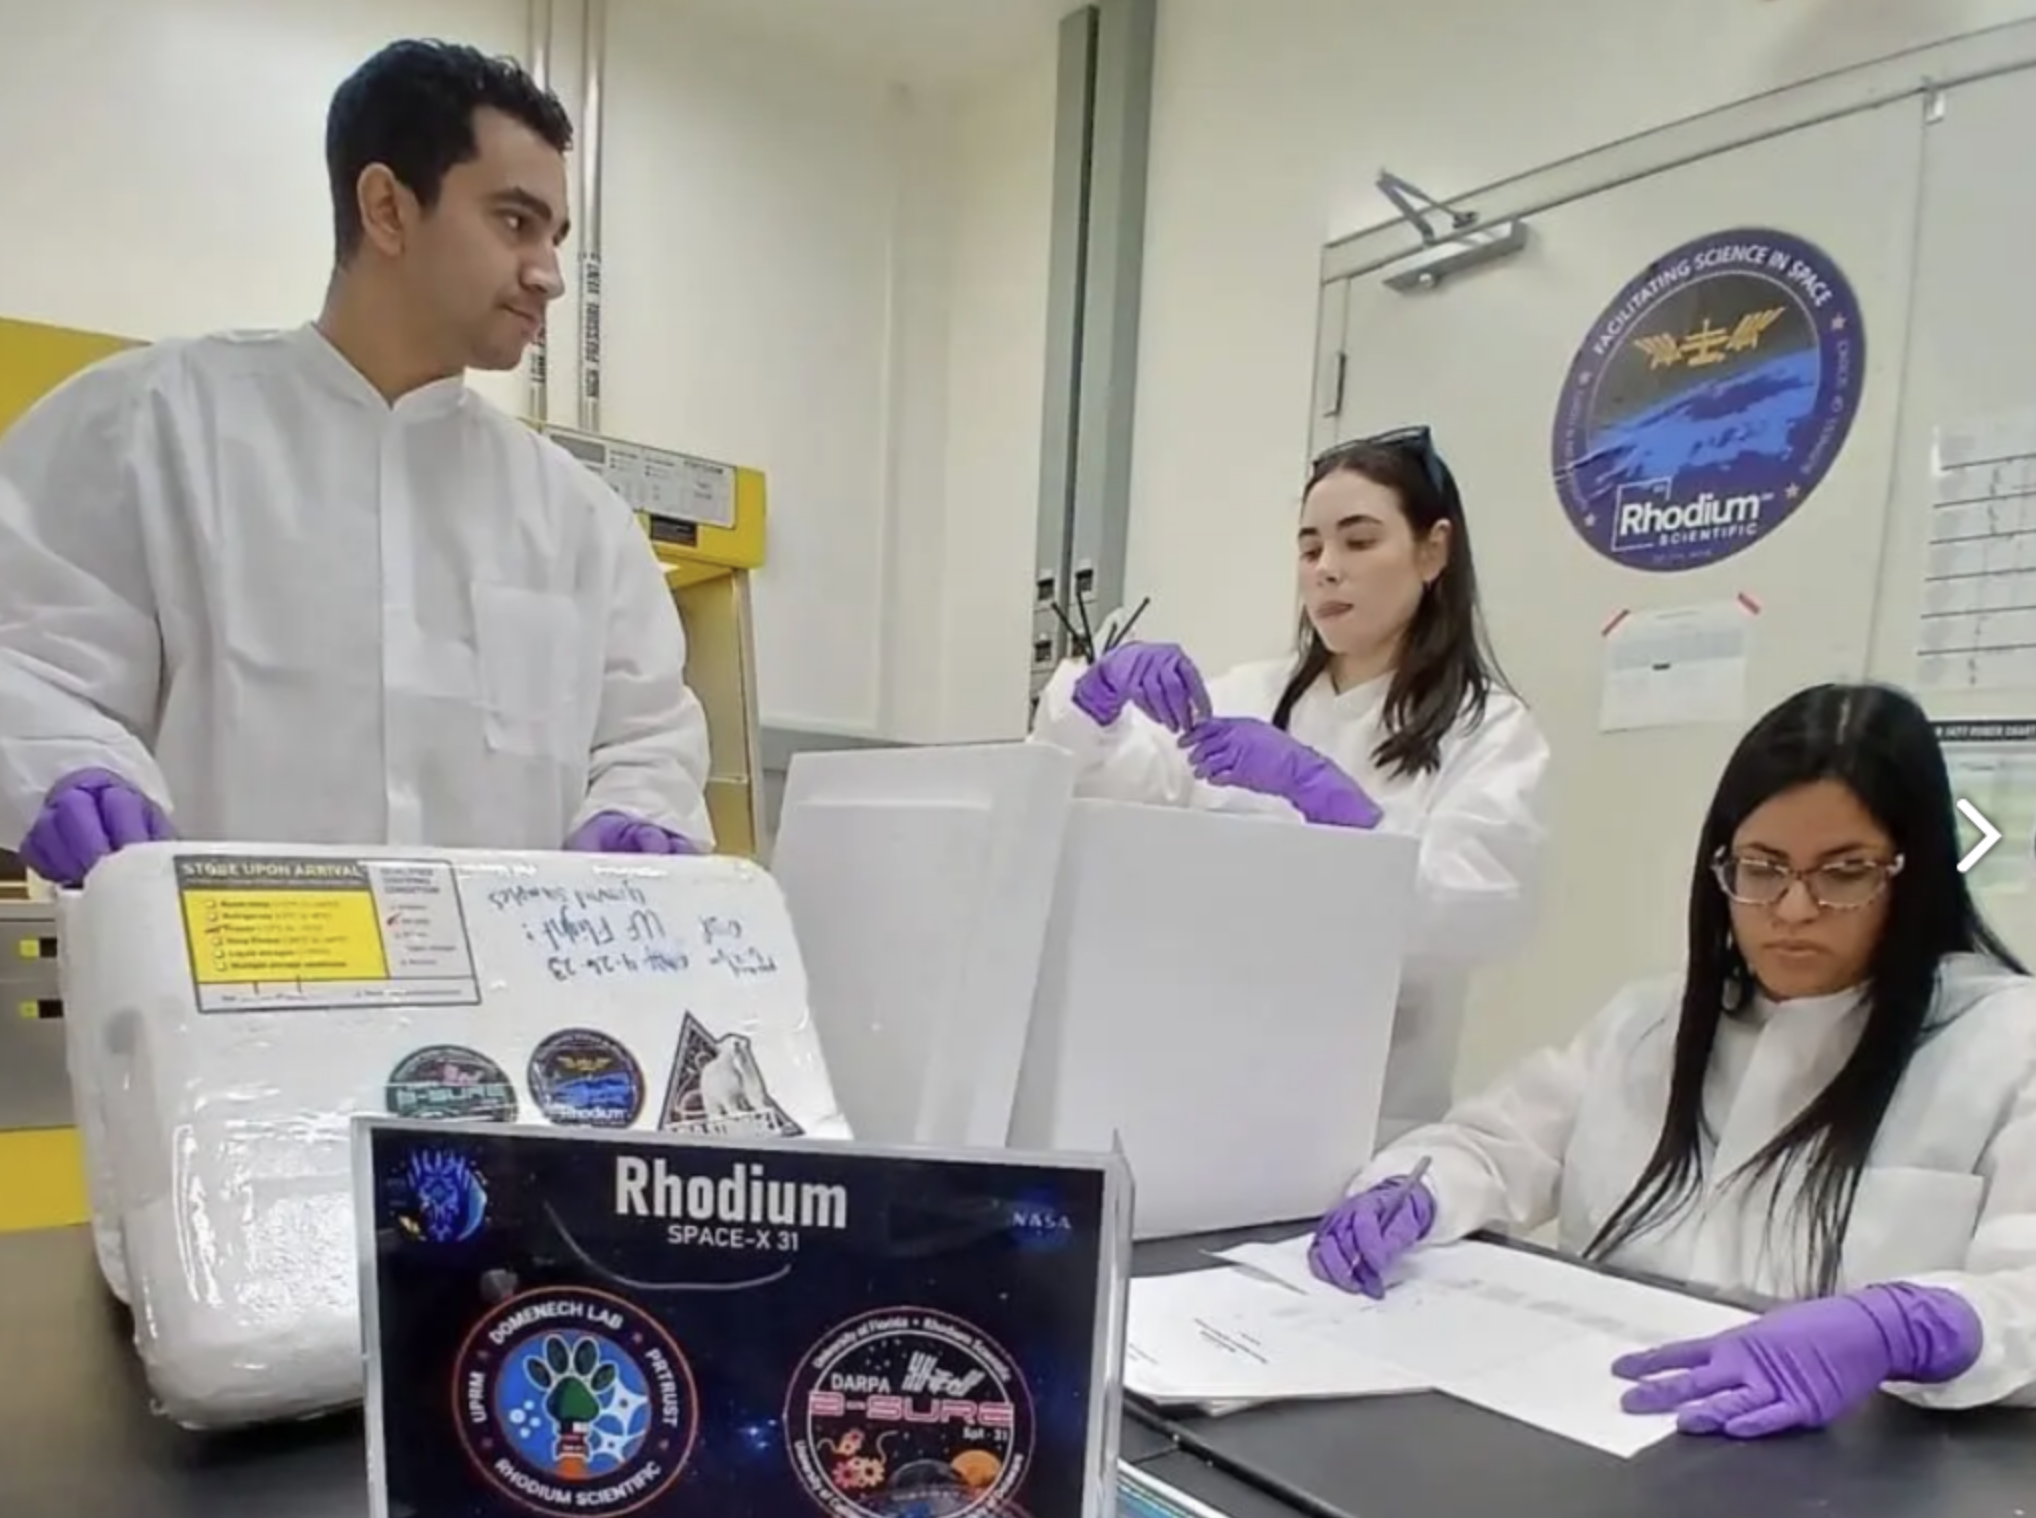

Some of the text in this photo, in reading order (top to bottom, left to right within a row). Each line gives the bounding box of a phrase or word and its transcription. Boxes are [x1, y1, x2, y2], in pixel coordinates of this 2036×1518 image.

[1593, 244, 1834, 355] FACILITATING SCIENCE IN SPACE
[1620, 493, 1760, 537] Rhodium
[1658, 521, 1758, 547] SCIENTIFIC
[242, 862, 293, 877] UPON
[295, 863, 359, 878] ARRIVAL
[616, 1155, 847, 1229] Rhodium
[667, 1224, 799, 1252] SPACE-X 31
[1013, 1210, 1072, 1229] NASA
[488, 1301, 624, 1346] DOMENECH LAB
[468, 1371, 488, 1424] UPRM
[645, 1347, 680, 1429] PRTRUST
[830, 1372, 891, 1394] DARPA
[809, 1389, 1015, 1427] B-SURE
[494, 1457, 662, 1507] RHODIUM SCIENTIFIC
